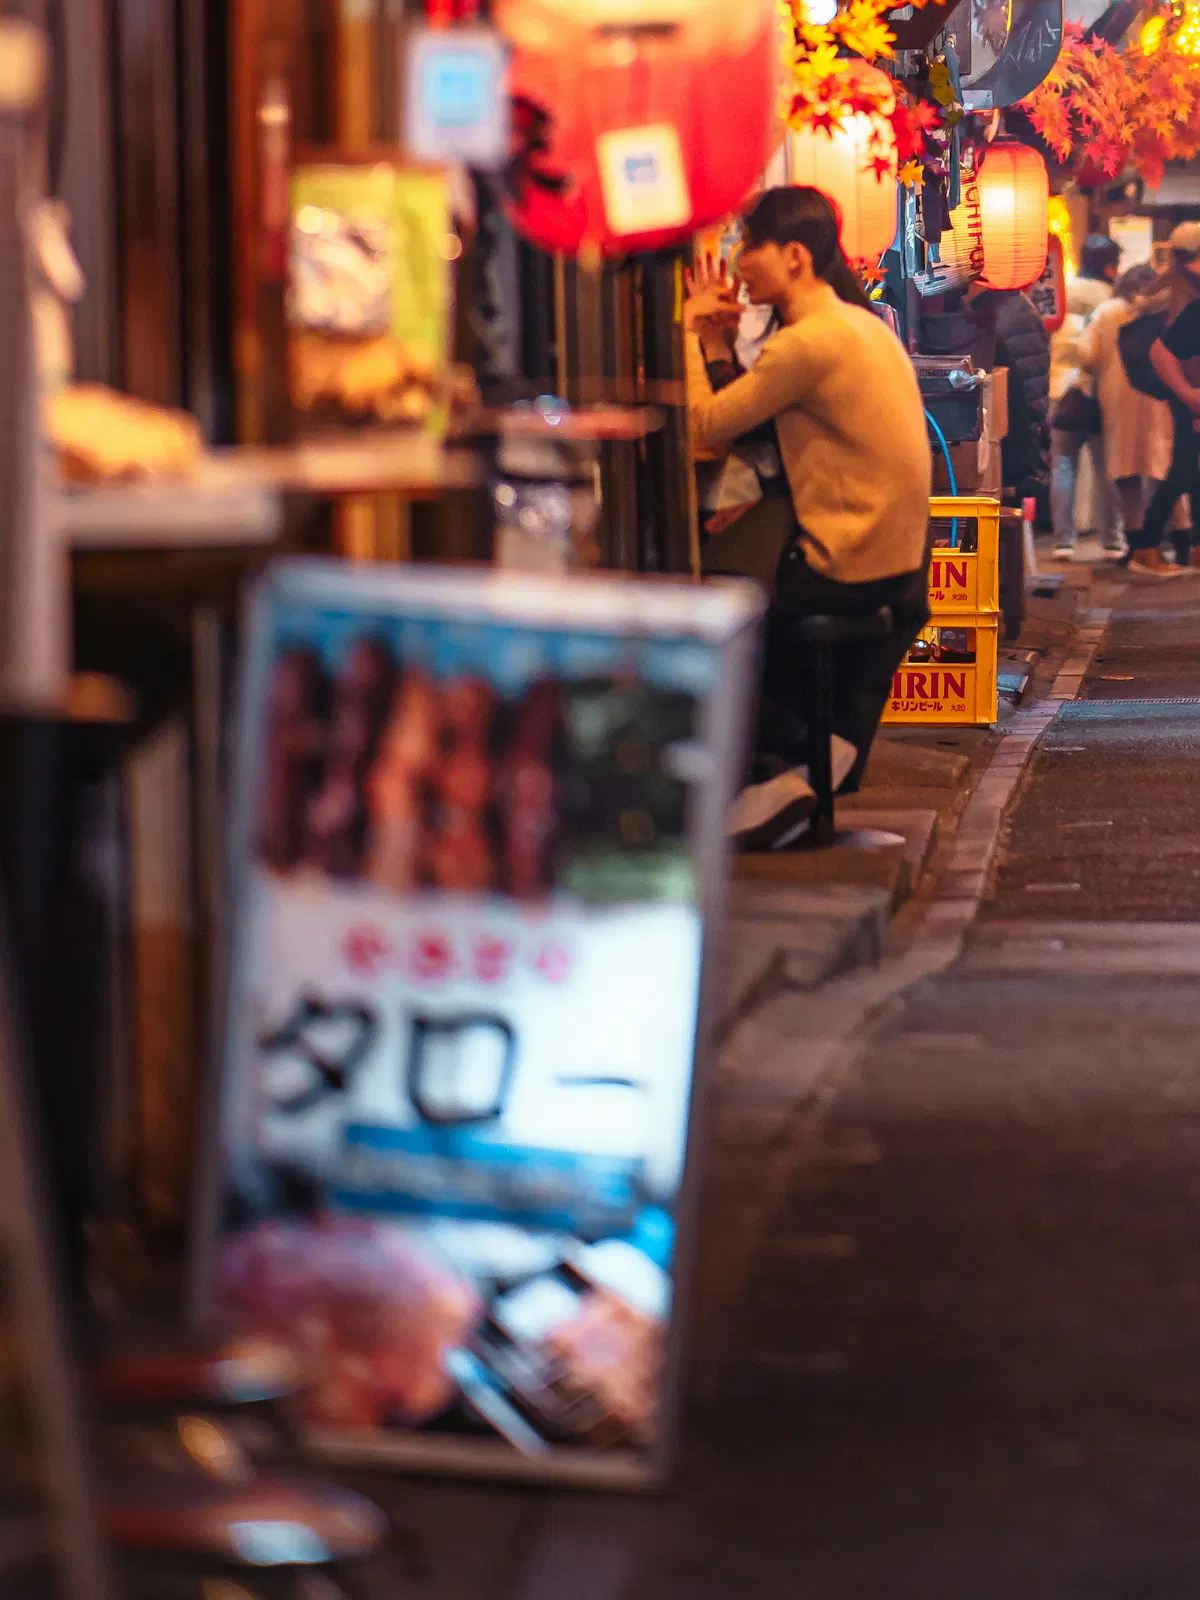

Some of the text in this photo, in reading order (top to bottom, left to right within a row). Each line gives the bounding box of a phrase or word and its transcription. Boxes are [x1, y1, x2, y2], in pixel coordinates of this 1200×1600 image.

[888, 672, 966, 699] IRIN
[891, 700, 943, 712] キリンビール
[258, 993, 650, 1127] タロー
